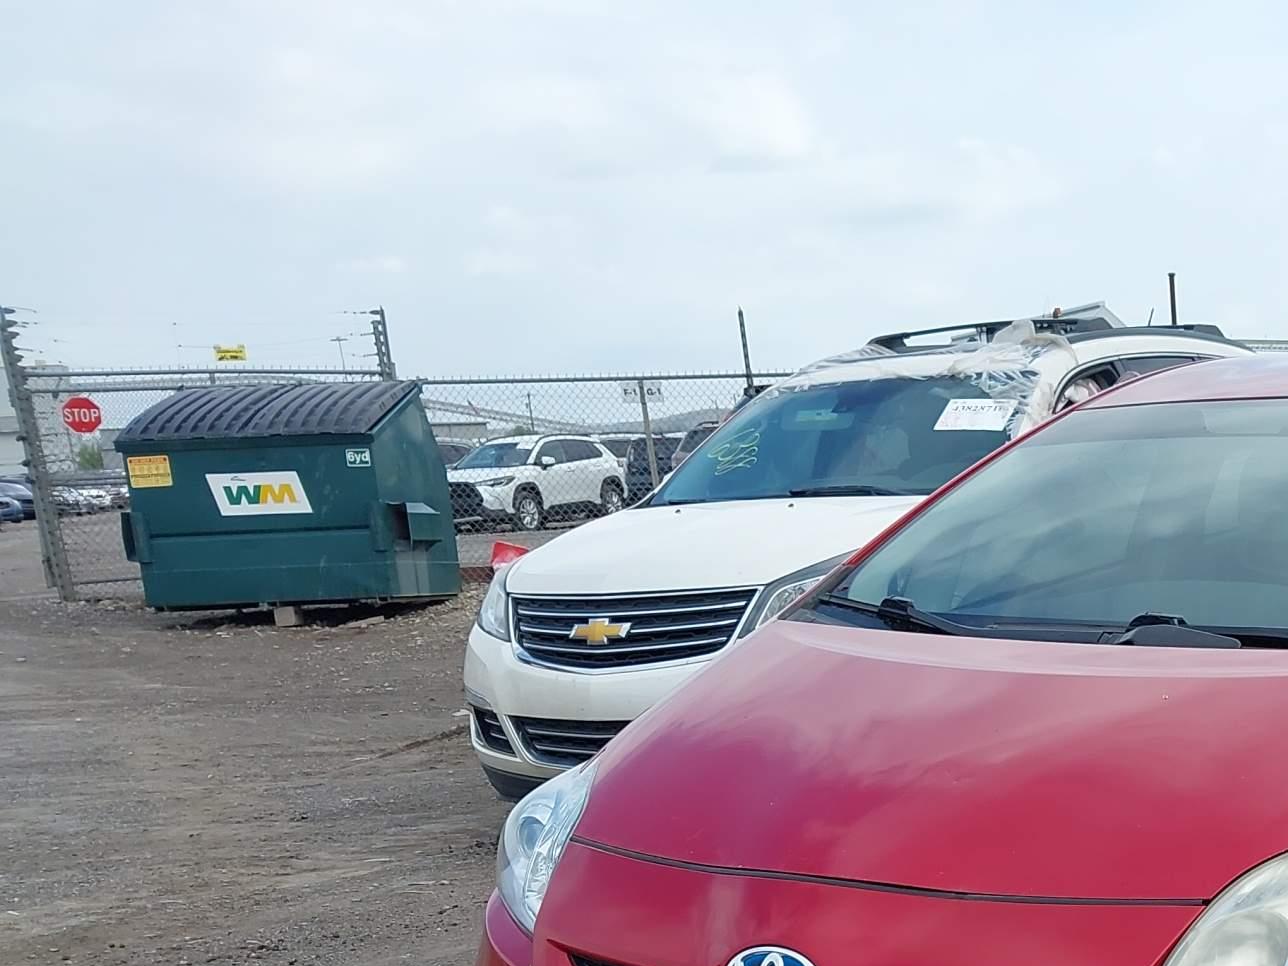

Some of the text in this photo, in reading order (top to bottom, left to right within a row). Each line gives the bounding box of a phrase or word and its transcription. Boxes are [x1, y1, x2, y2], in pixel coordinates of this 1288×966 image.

[64, 408, 99, 422] STOP
[347, 451, 369, 464] 6yd
[222, 483, 298, 506] WM
